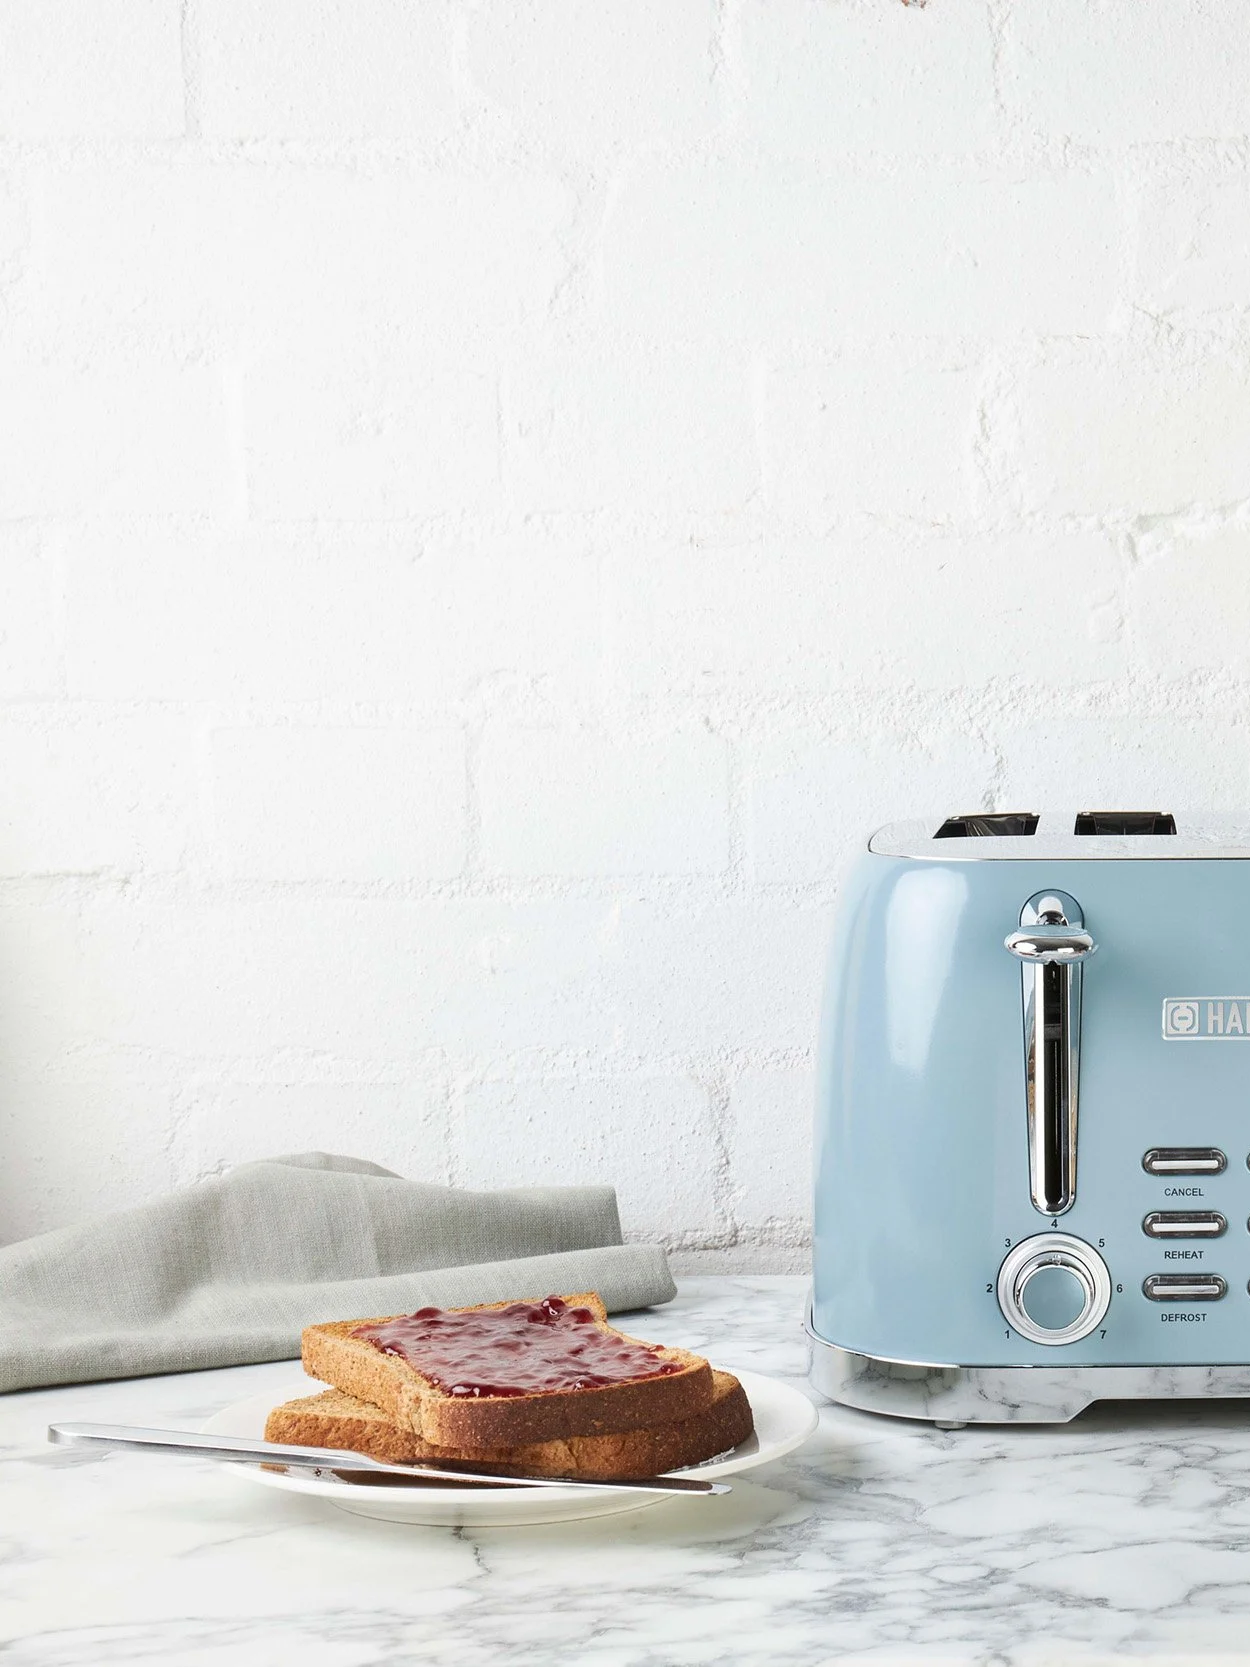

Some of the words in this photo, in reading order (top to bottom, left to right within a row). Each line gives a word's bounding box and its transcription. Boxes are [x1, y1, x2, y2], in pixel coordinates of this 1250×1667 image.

[1164, 1187, 1204, 1197] CANCEL
[1050, 1218, 1058, 1229] 4
[1004, 1238, 1012, 1248] 3
[1098, 1238, 1105, 1248] 5
[1164, 1250, 1204, 1260] REHEAT
[986, 1283, 993, 1293] 2
[1116, 1283, 1123, 1294] 6
[1161, 1313, 1207, 1322] DEFROST
[1100, 1329, 1107, 1340] 7
